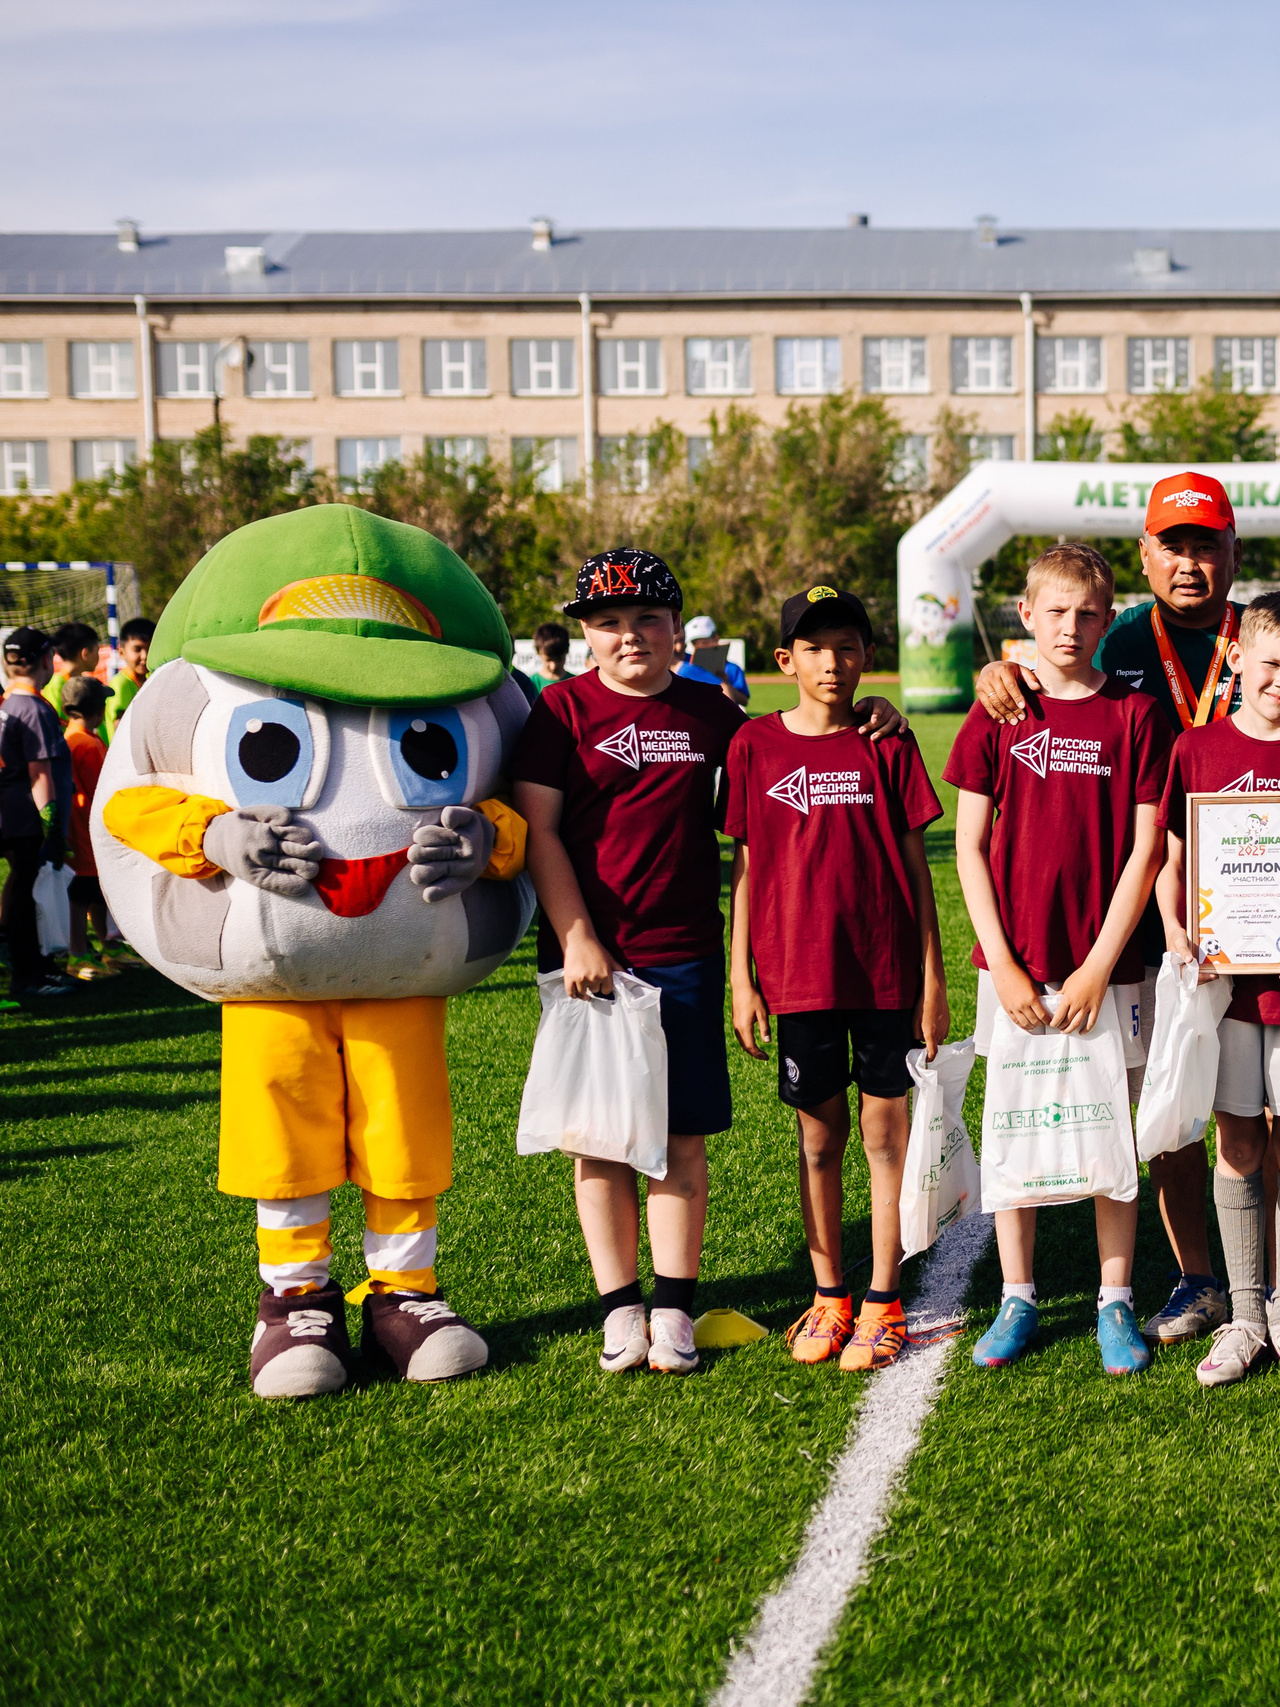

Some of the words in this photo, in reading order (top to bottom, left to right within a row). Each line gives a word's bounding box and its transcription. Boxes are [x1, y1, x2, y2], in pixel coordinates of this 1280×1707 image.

[639, 730, 690, 742] РУССКАЯ
[640, 741, 690, 751] МЕДНАЯ
[1051, 737, 1102, 752] РУССКАЯ
[642, 751, 705, 763] КОМПАНИЯ
[1050, 749, 1099, 763] МЕДНАЯ
[1049, 761, 1112, 777] КОМПАНИЯ
[809, 771, 861, 783] РУССКАЯ
[809, 782, 859, 795] МЕДНАЯ
[810, 794, 874, 806] КОМПАНИЯ
[1238, 845, 1266, 856] 2025
[1023, 1177, 1088, 1188] METROSHKA.RU
